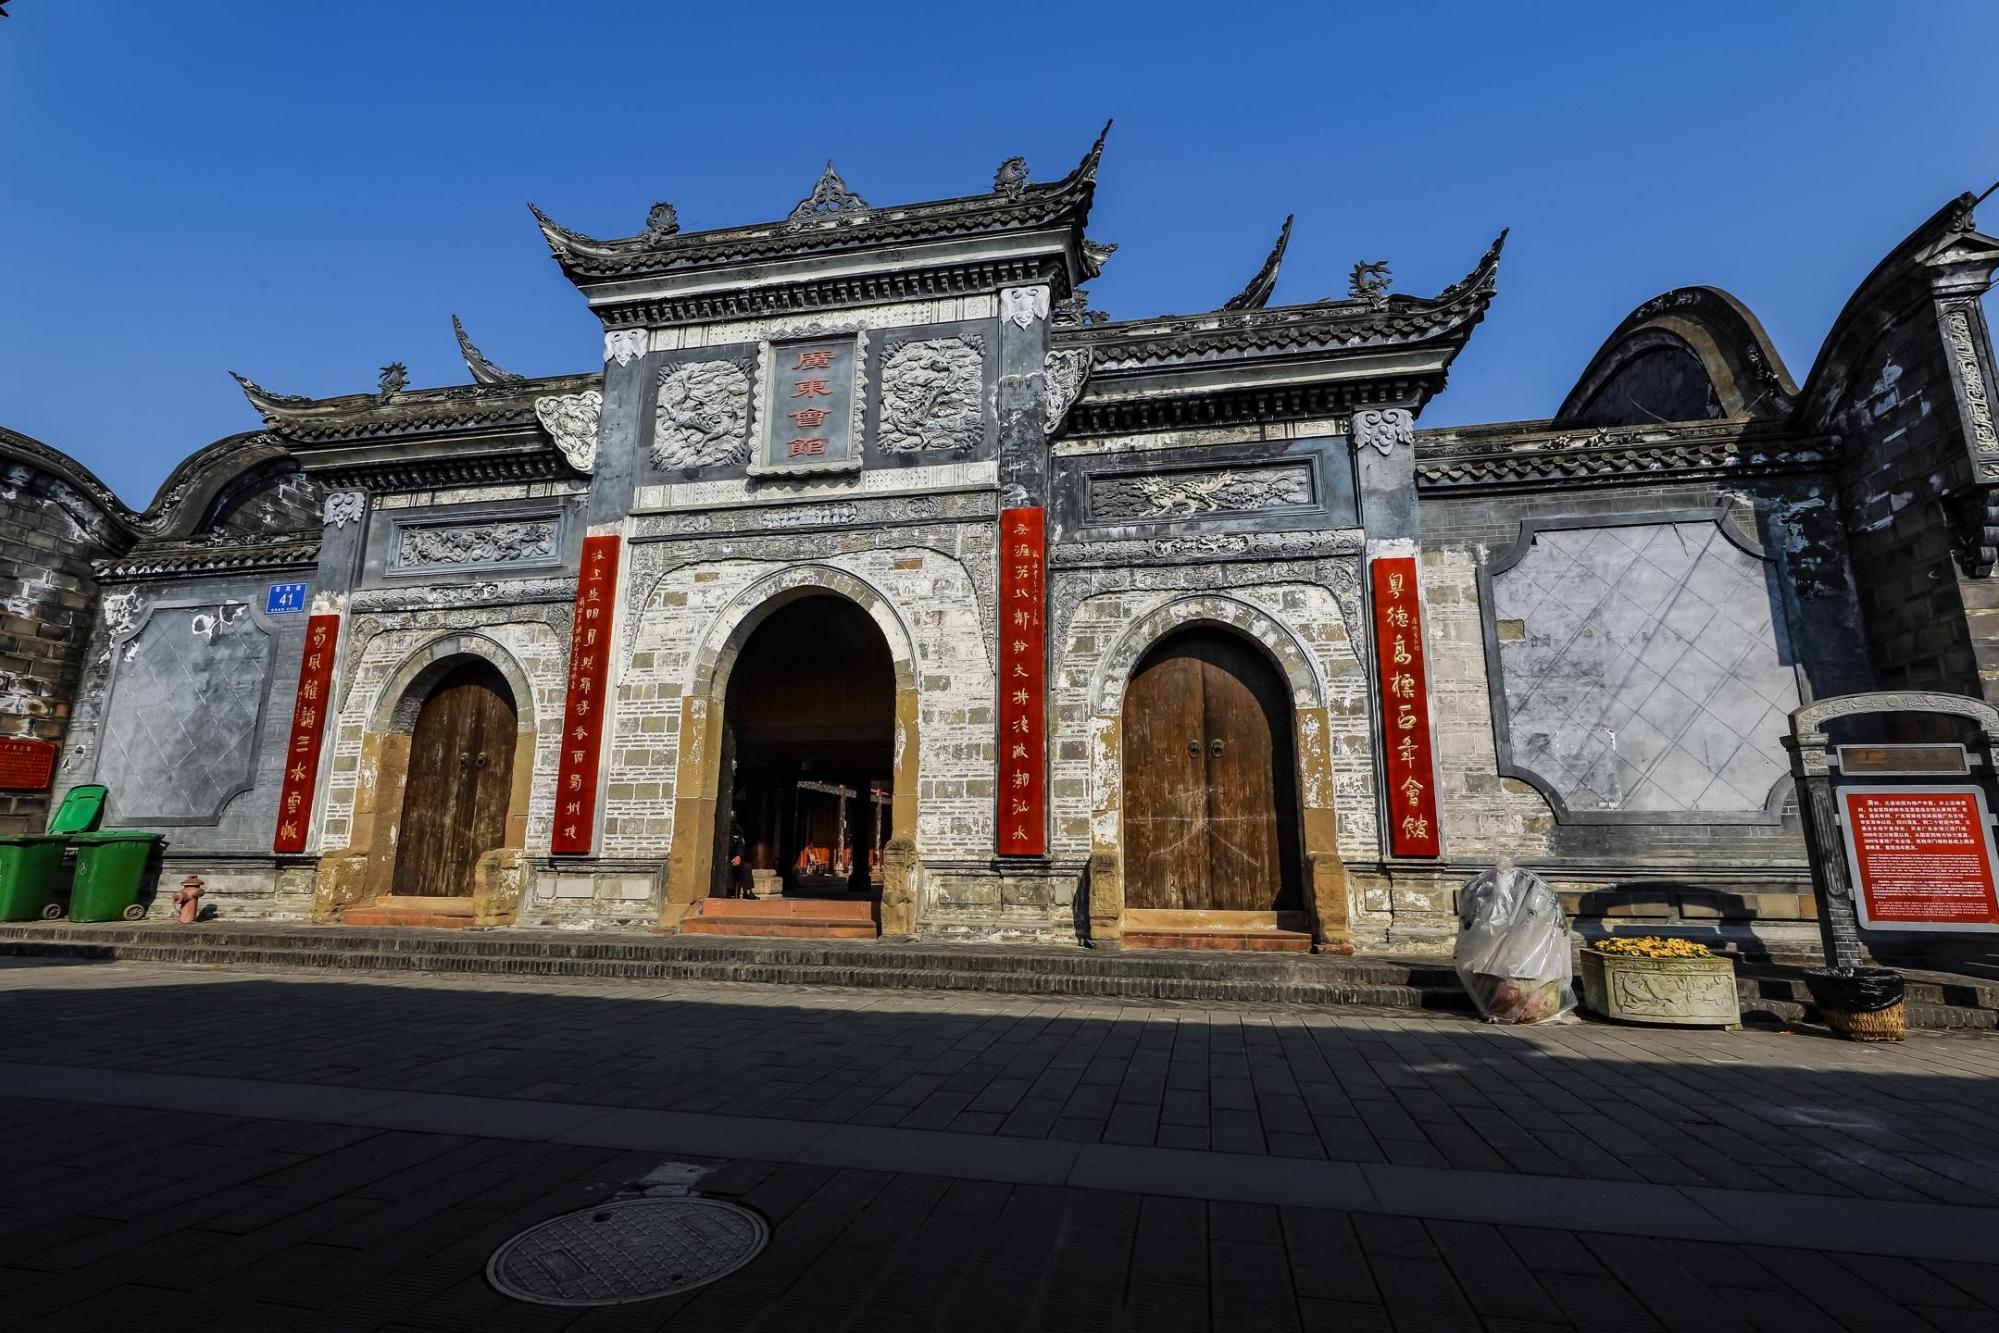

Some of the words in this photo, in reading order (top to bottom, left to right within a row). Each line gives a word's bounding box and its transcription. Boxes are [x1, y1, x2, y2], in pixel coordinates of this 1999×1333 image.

[786, 350, 836, 458] 廣東會館
[279, 593, 293, 605] 41
